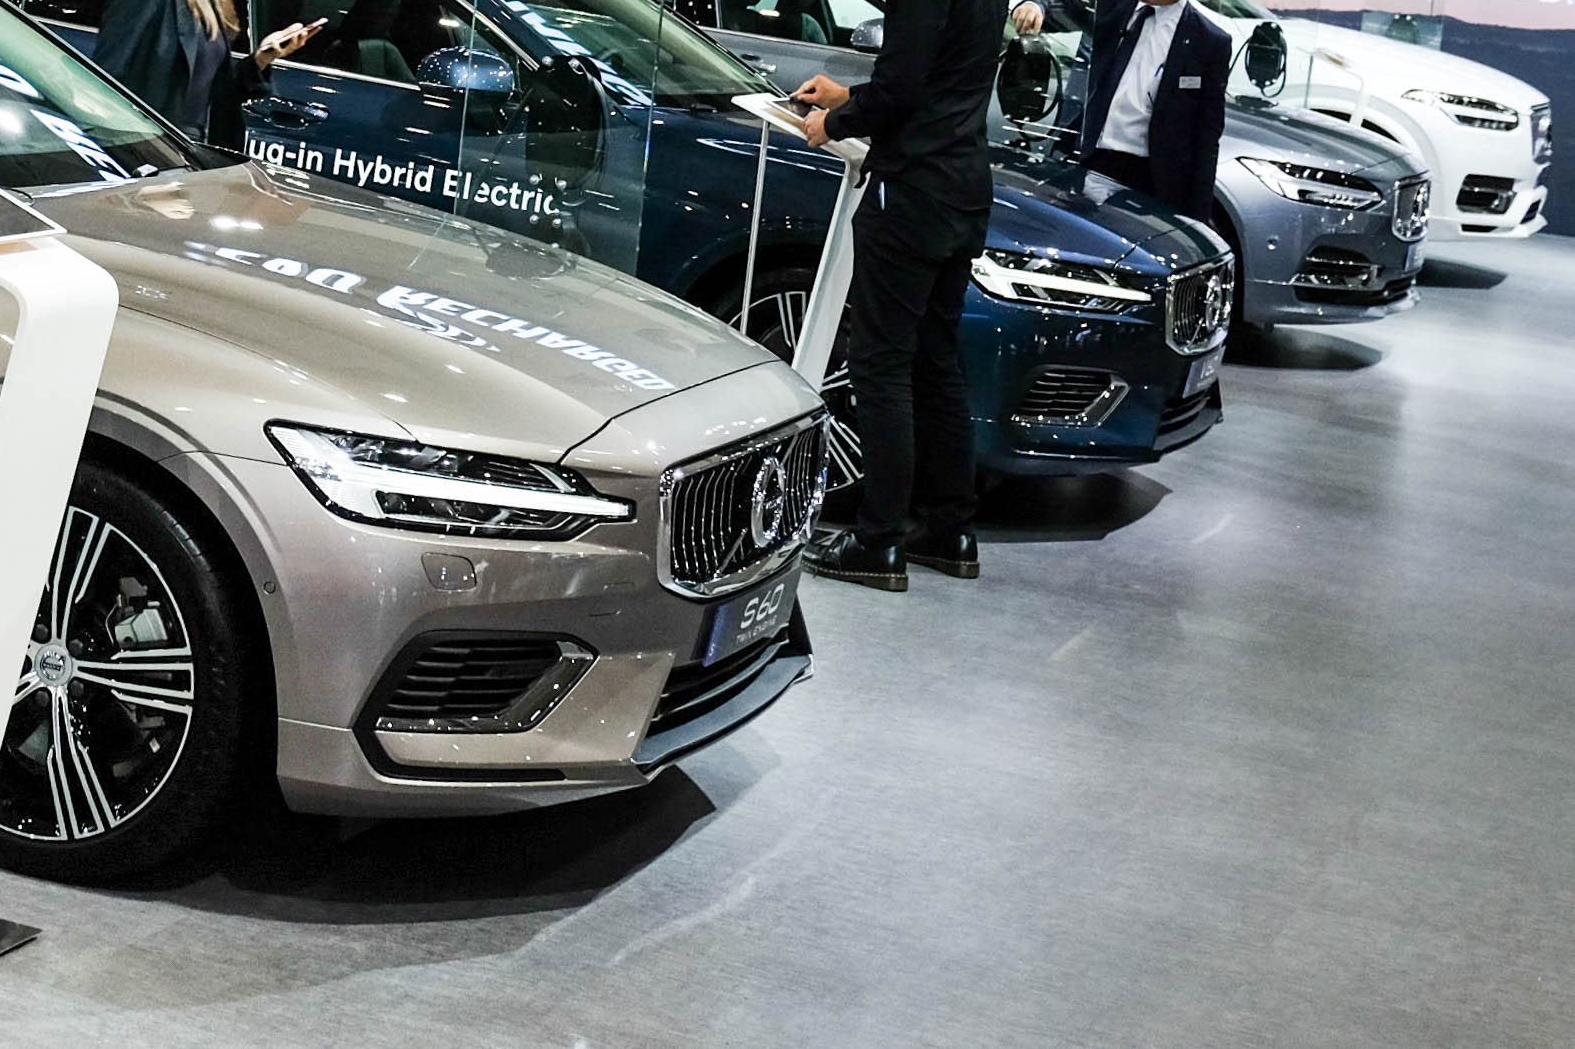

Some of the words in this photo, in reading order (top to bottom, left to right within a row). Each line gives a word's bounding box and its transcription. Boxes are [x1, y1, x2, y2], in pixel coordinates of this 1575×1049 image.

[244, 129, 324, 173] lug-in
[332, 148, 435, 194] Hybrid
[740, 583, 785, 629] S60
